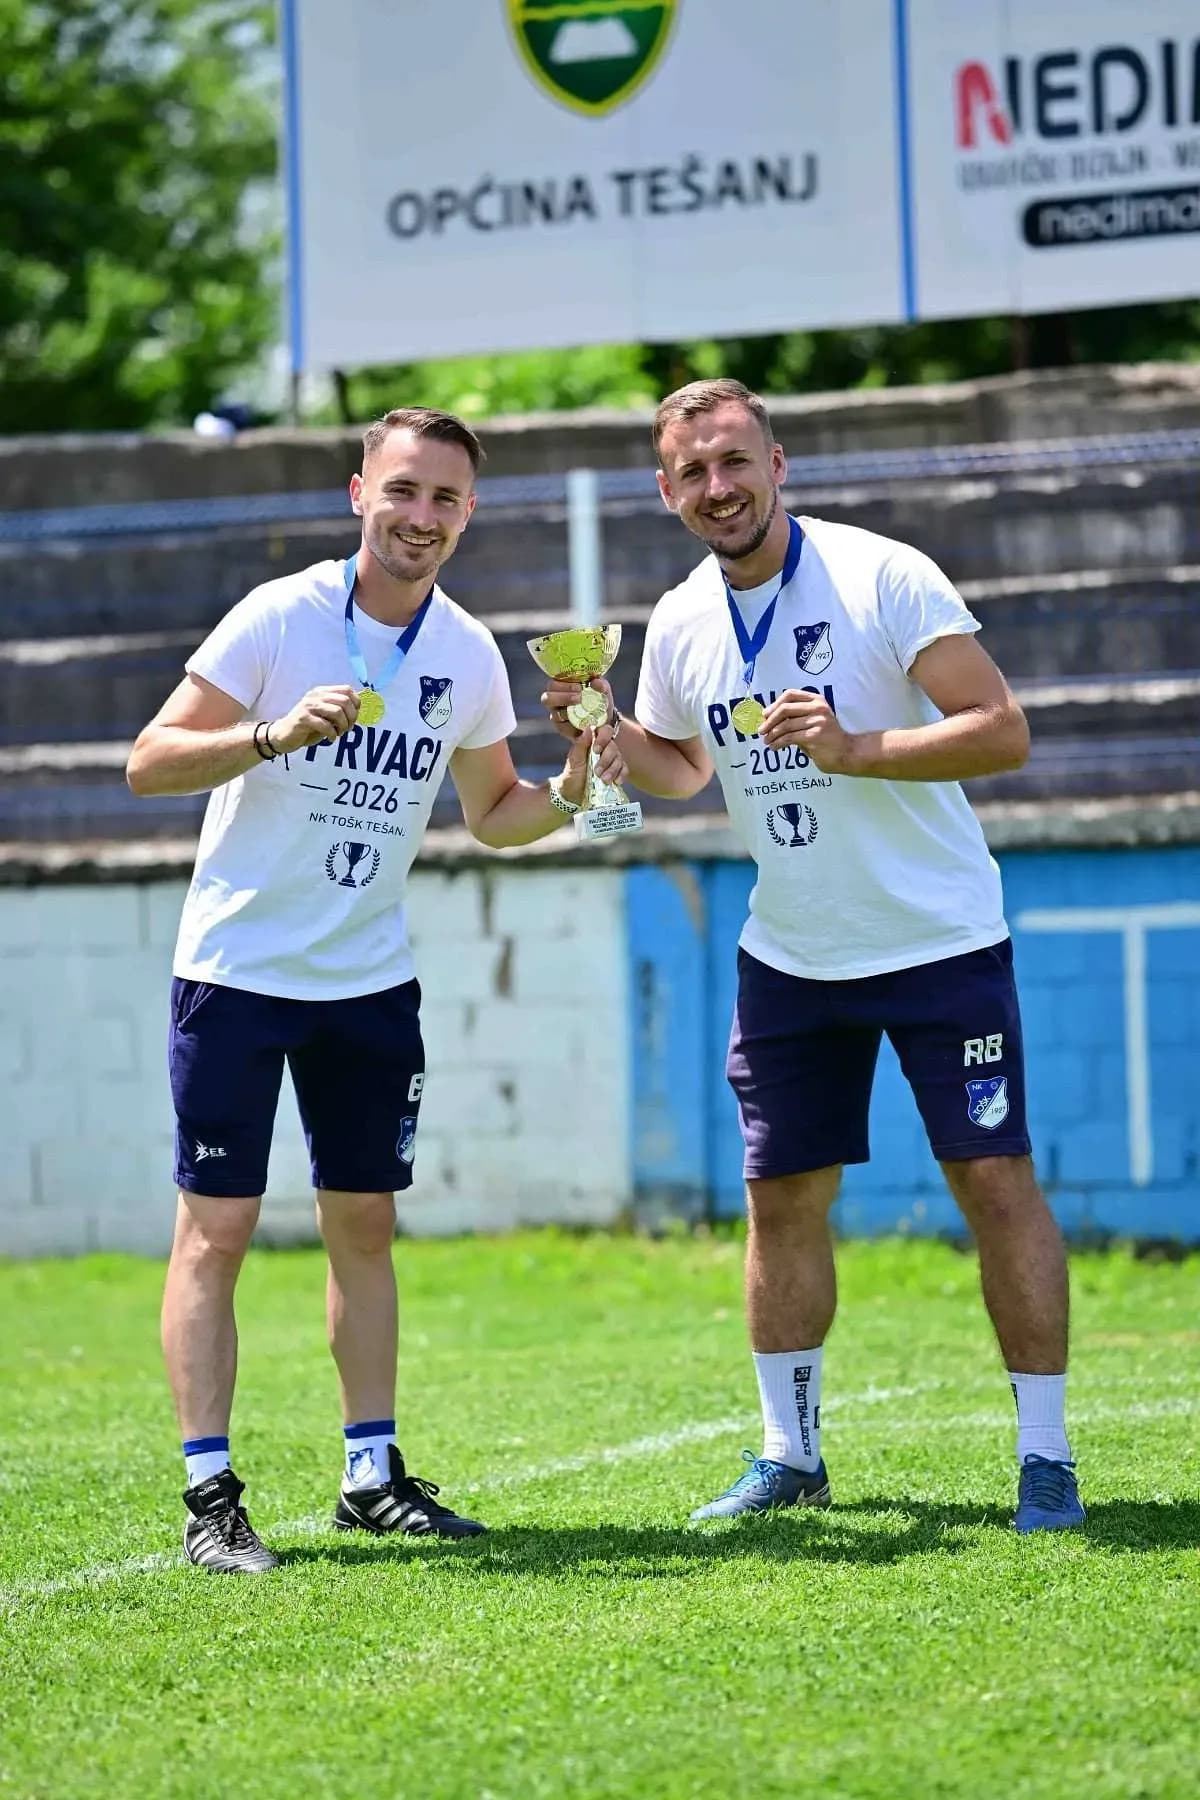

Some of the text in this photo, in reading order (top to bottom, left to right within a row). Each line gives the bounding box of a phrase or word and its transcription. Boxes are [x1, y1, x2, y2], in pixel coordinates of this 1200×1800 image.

[386, 152, 818, 239] OPĆINA TEŠANJ
[815, 651, 831, 661] 1927
[750, 746, 810, 775] 2026
[333, 778, 399, 814] 2026
[755, 781, 788, 796] TOŠK
[789, 777, 832, 791] TEŠANJ
[309, 812, 327, 823] NK
[331, 815, 363, 830] TOŠK
